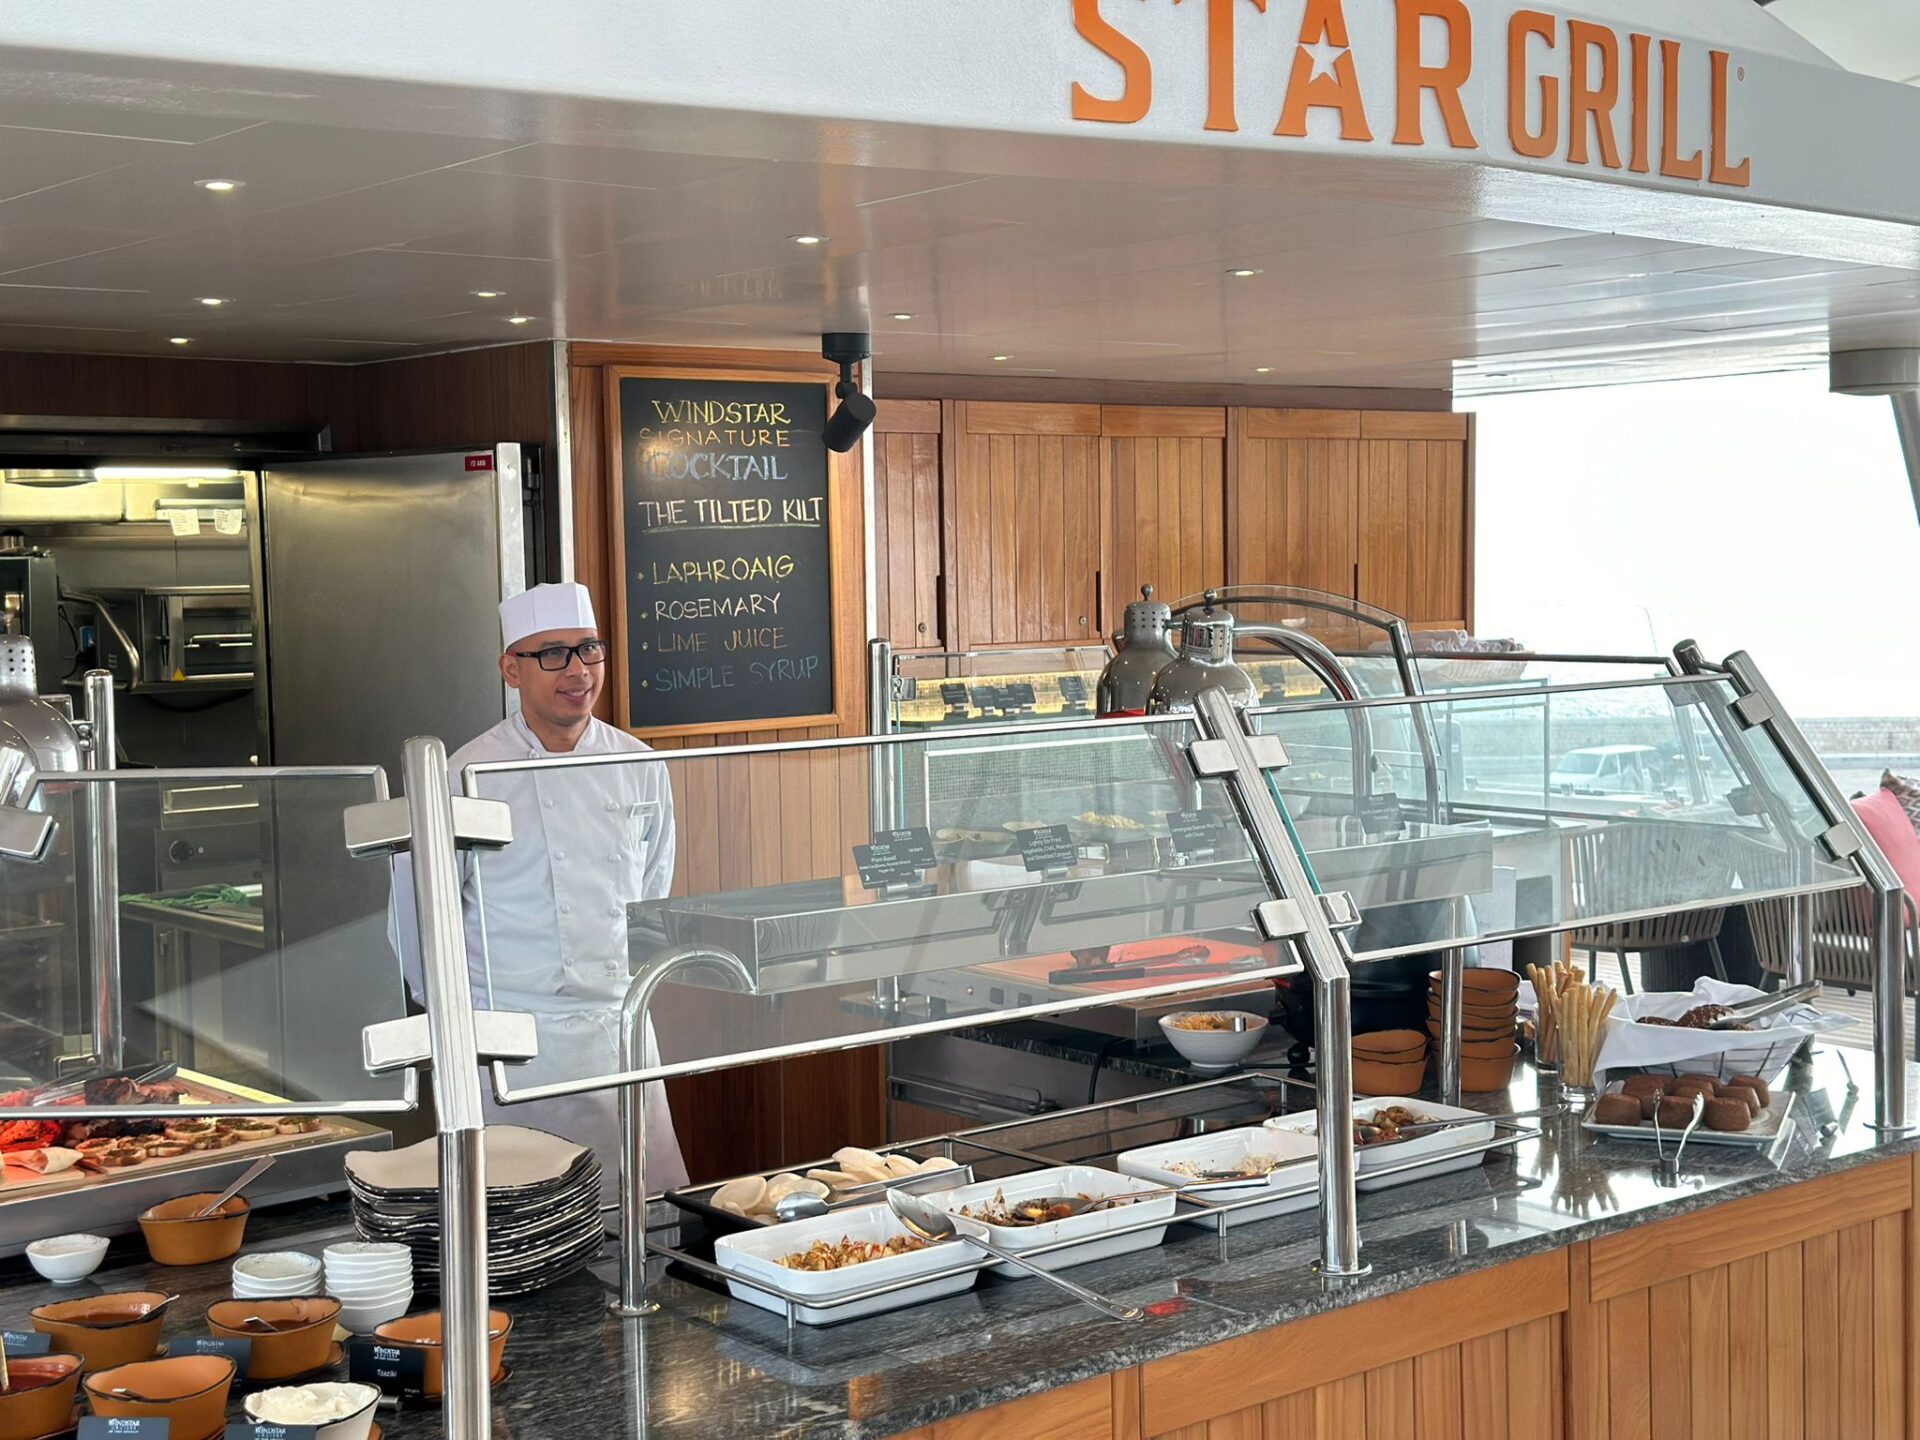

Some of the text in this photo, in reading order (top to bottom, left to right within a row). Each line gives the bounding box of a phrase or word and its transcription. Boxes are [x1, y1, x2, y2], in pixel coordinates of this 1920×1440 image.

[1071, 0, 1750, 187] STAR GRILL
[652, 399, 791, 426] WINDSTAR
[640, 427, 791, 448] SIGNATURE
[647, 451, 788, 481] COCKTAIL
[638, 497, 823, 527] THE TILTED KILT
[653, 555, 794, 585] LAPHROAIG
[655, 592, 781, 622] ROSEMARY
[658, 627, 788, 653] LIME JUICE
[655, 655, 818, 692] SIMPLE SYRUP
